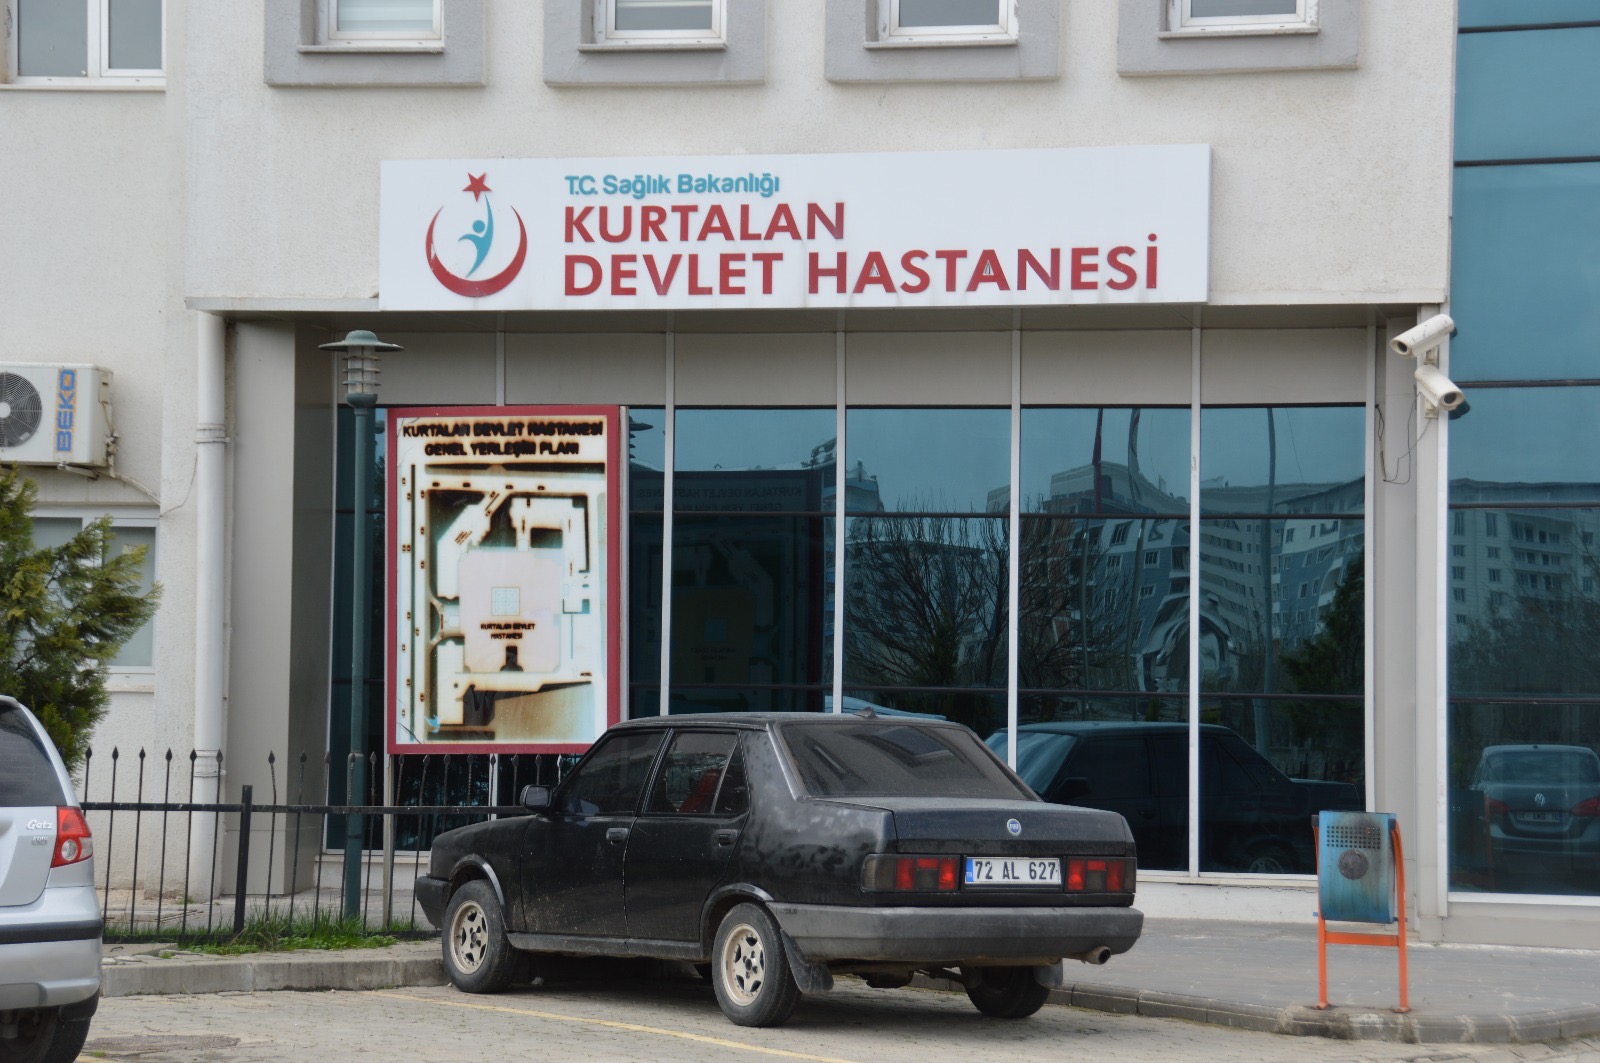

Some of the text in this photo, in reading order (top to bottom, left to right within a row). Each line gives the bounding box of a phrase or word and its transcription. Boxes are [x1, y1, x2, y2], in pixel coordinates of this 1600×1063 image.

[565, 173, 780, 200] T.C. Sağlık Bakanlığı
[565, 202, 844, 243] KURTALAN
[565, 233, 1157, 296] DEVLET HASTANESİ
[57, 369, 76, 452] BEKO
[403, 424, 470, 437] KURTALAN
[474, 422, 525, 436] DEVLET
[424, 442, 467, 456] GENEL
[27, 819, 54, 830] Getz
[975, 861, 1056, 880] 72 AL 627
